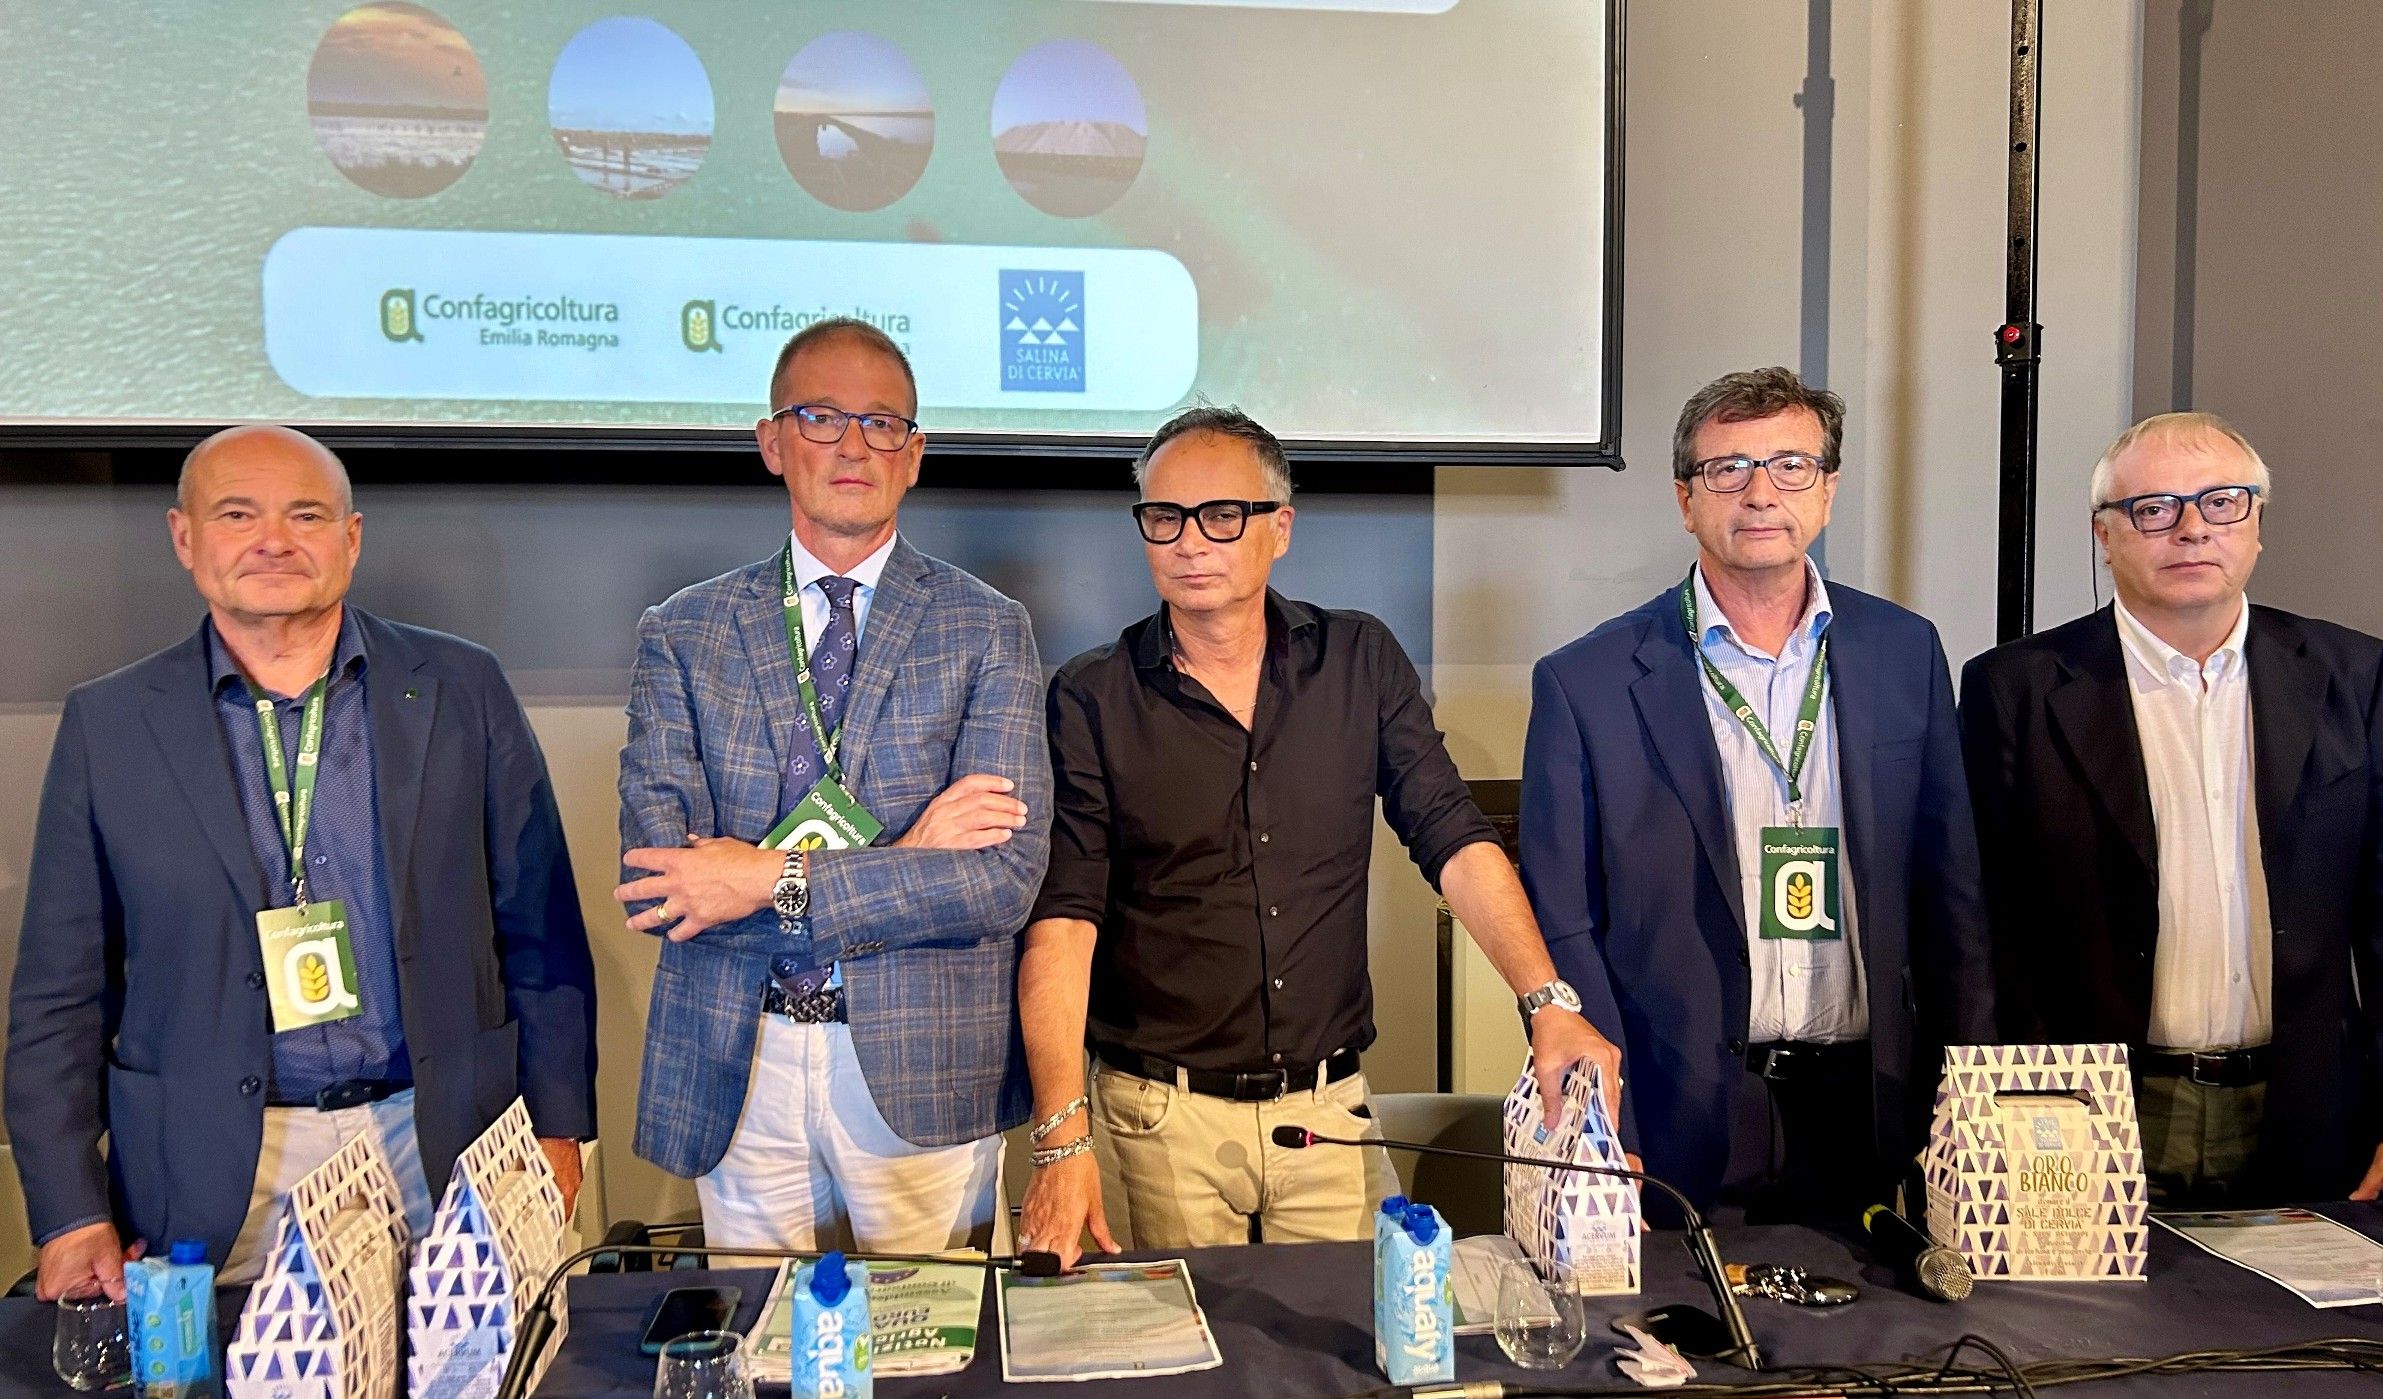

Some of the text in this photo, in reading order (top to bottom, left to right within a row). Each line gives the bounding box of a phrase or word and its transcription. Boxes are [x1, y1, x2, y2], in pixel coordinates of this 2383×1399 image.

[423, 293, 619, 326] Confagricoltura
[480, 328, 620, 352] Emilia Romagna
[1016, 348, 1070, 364] SALINA
[1007, 365, 1079, 381] DI CERVIA
[810, 791, 867, 846] Confagricoltura
[1763, 844, 1836, 856] Confagricoltura
[2032, 1154, 2072, 1174] ORO
[2020, 1171, 2089, 1193] BIANCO
[2016, 1207, 2048, 1219] SALE
[2024, 1219, 2082, 1230] DI CERVIA
[874, 1327, 940, 1344] Agric
[808, 1310, 846, 1399] aqua
[873, 1336, 947, 1355] Notizi
